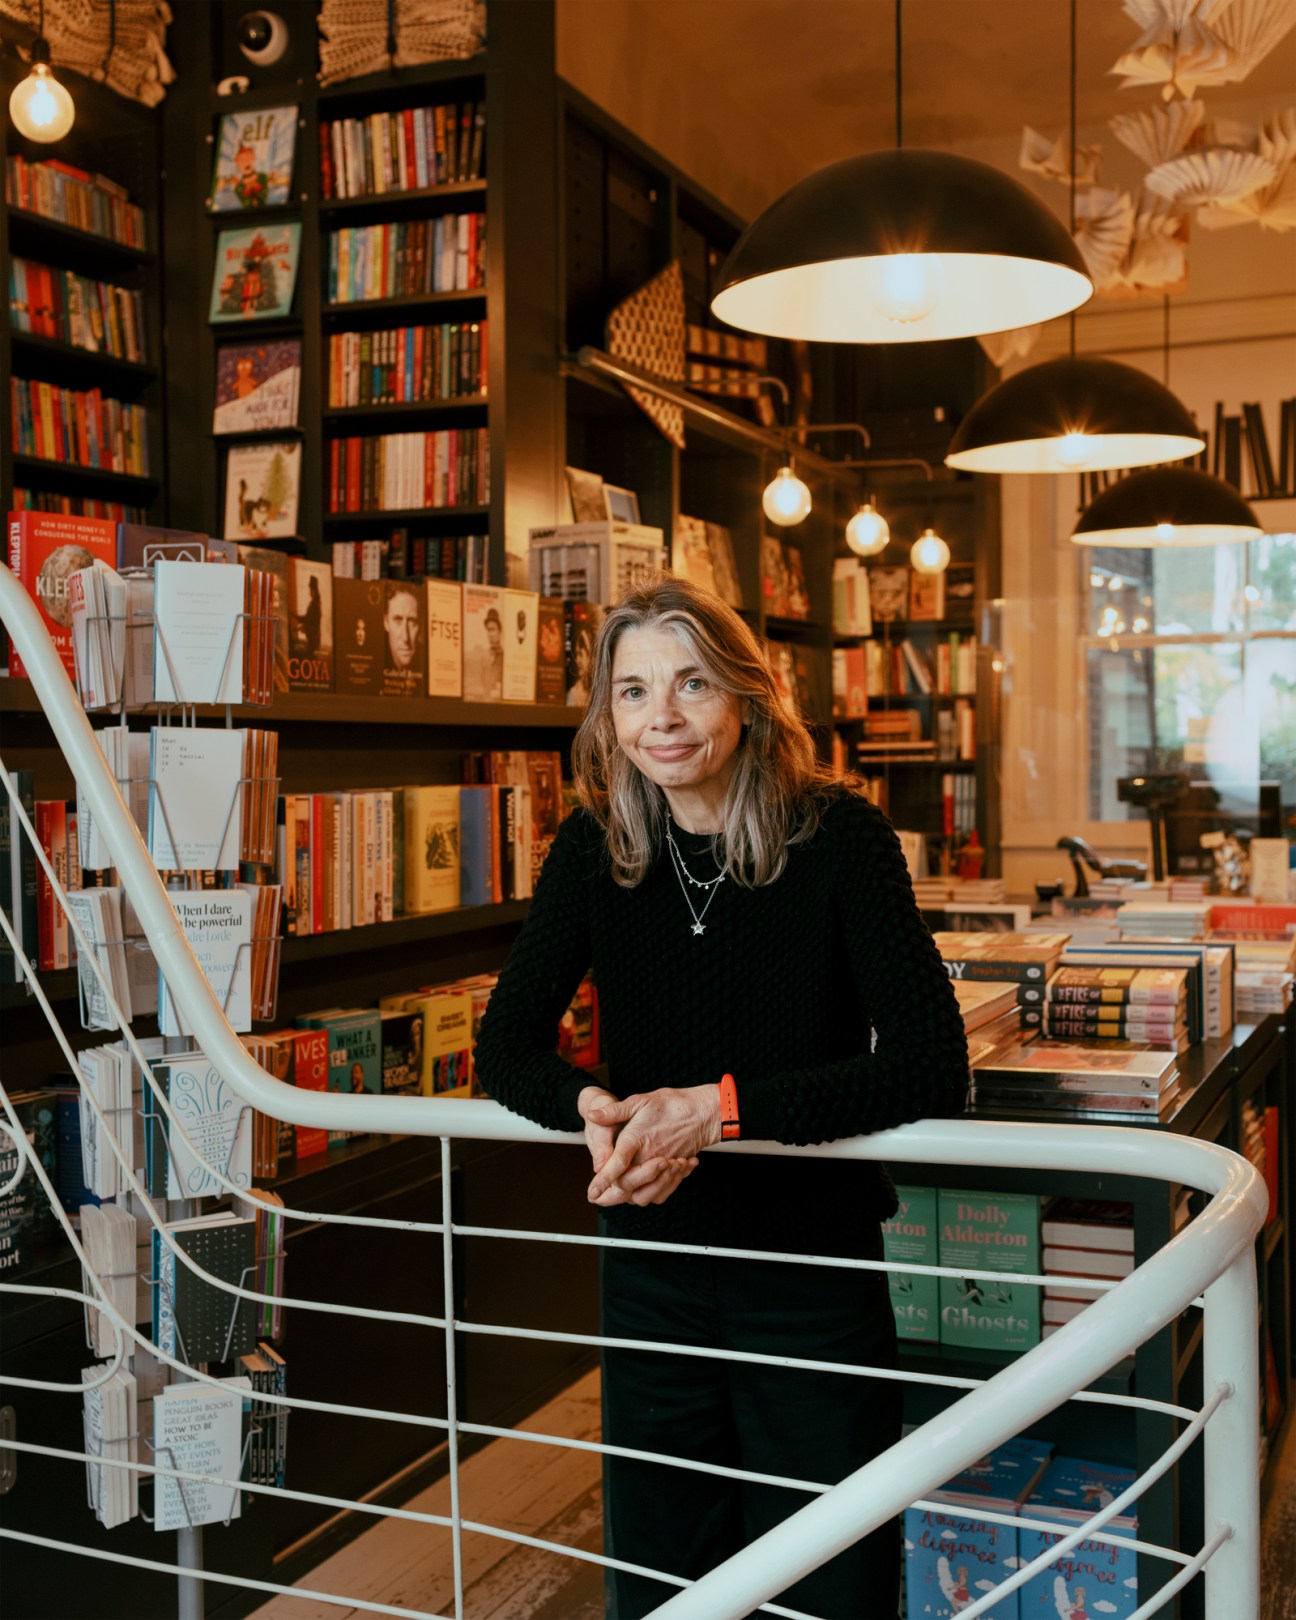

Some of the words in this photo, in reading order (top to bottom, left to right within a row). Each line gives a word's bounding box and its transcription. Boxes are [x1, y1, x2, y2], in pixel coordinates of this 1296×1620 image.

[242, 115, 274, 141] elf
[431, 620, 460, 640] FTSE
[287, 658, 330, 680] GOYA
[174, 904, 202, 915] When
[204, 903, 208, 915] I
[210, 903, 232, 915] dare
[184, 916, 197, 928] be
[199, 914, 242, 930] powerful
[207, 929, 232, 942] Lorde
[1065, 987, 1089, 1002] FIRE
[1062, 1005, 1086, 1019] FIRE
[1061, 1022, 1085, 1036] FIRE
[336, 1031, 363, 1049] WHAT
[365, 1029, 372, 1042] A
[295, 1037, 327, 1064] IVES
[957, 1203, 1011, 1229] Dolly
[881, 1221, 927, 1238] erton
[941, 1224, 1028, 1248] Alderton
[895, 1304, 928, 1321] sts
[941, 1305, 1030, 1333] Ghosts
[164, 1405, 203, 1416] PENGUIN
[205, 1400, 234, 1411] BOOKS
[164, 1415, 192, 1425] GREAT
[194, 1412, 218, 1422] IDEAS
[164, 1426, 186, 1435] HOW
[189, 1424, 201, 1432] TO
[204, 1422, 213, 1430] BE
[174, 1433, 199, 1443] STOIC
[194, 1440, 216, 1449] HOPE
[165, 1453, 186, 1462] TAT
[190, 1449, 222, 1459] EVENTS
[198, 1496, 207, 1504] IN
[921, 1510, 998, 1545] Amazing
[1037, 1531, 1119, 1565] Amzing
